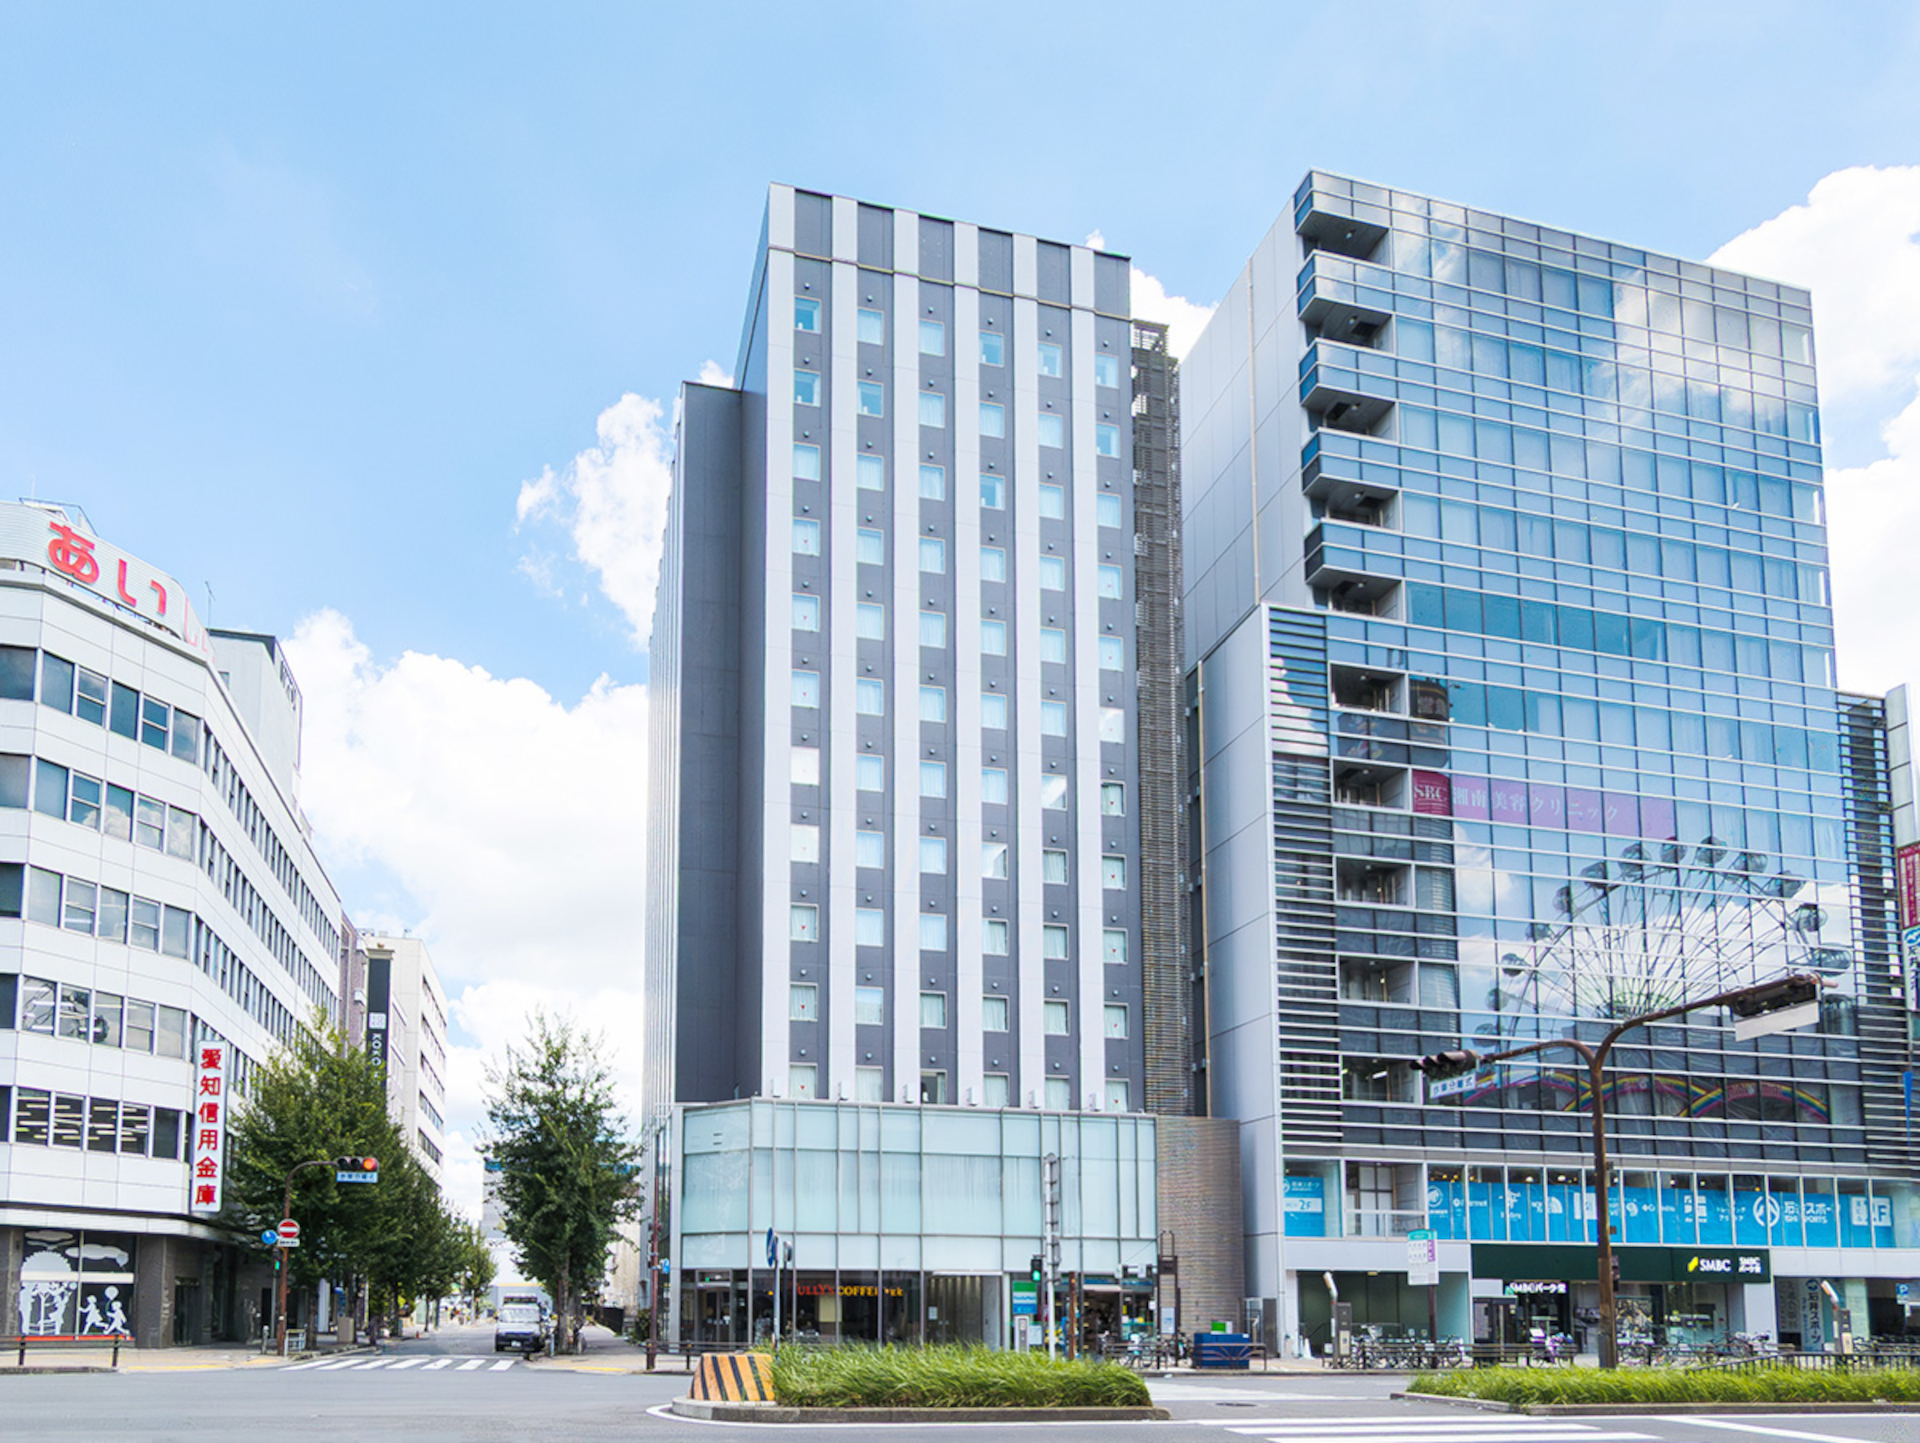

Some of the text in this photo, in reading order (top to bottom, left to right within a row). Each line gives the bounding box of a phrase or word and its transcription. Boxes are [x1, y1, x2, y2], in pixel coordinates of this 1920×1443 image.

[1414, 785, 1447, 802] SBC
[1452, 787, 1618, 821] 湘南美容クリニック
[195, 1048, 222, 1205] 愛知信用金庫
[1700, 1259, 1732, 1272] SMBC
[1808, 1293, 1821, 1344] 石井スポーツ
